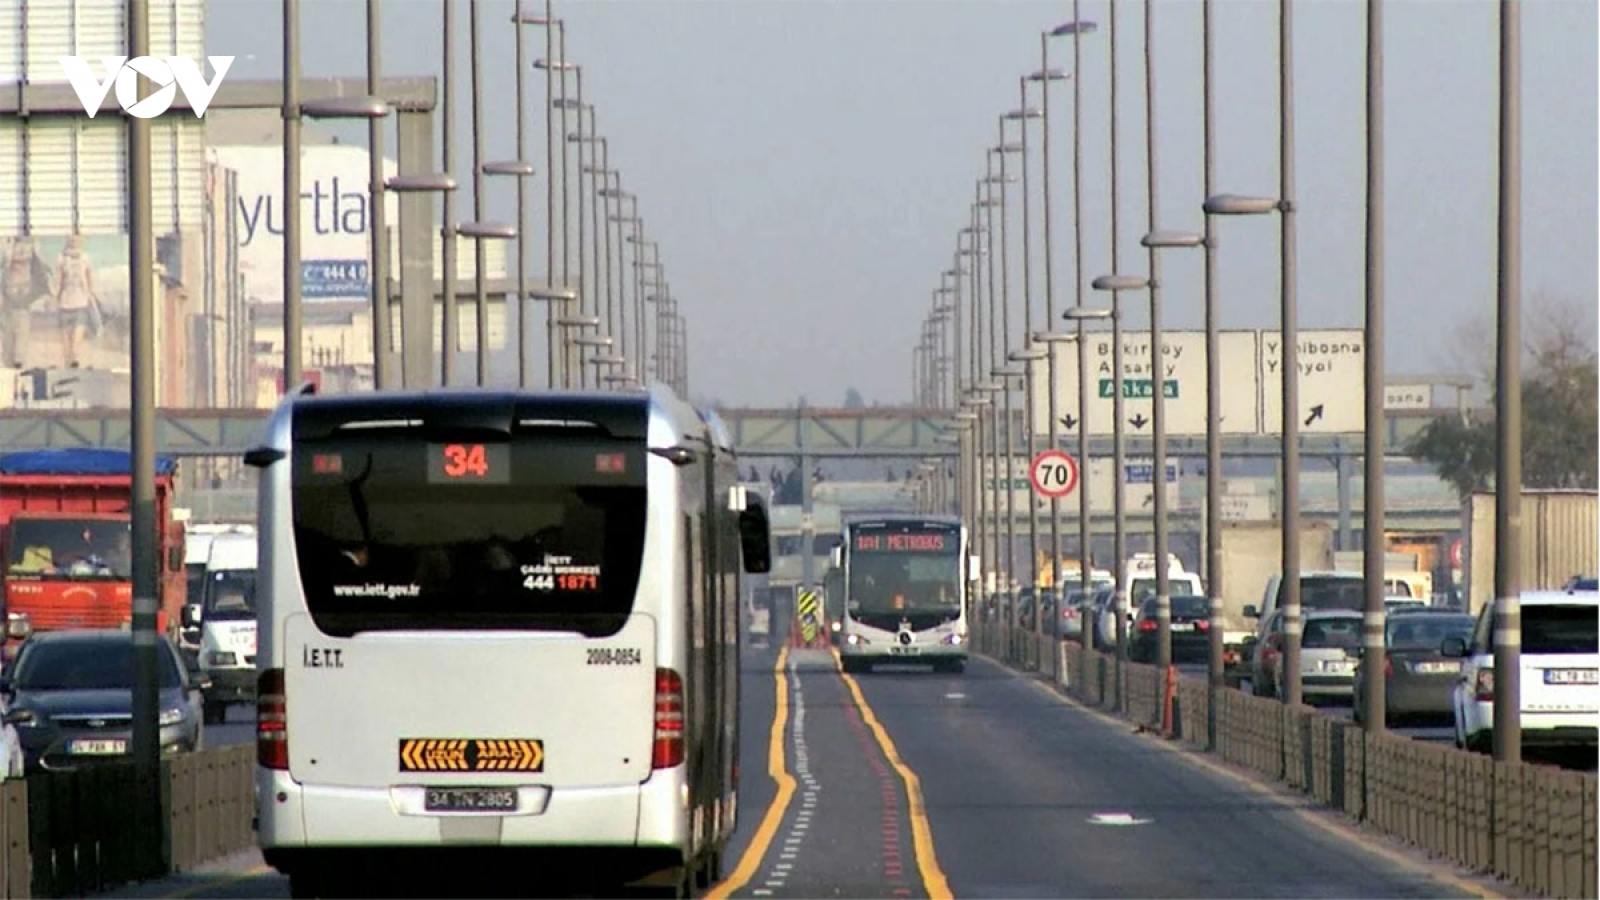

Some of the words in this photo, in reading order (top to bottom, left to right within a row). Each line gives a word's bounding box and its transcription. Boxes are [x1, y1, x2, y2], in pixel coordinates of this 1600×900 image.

[1267, 342, 1361, 355] Yibosna
[1099, 360, 1176, 377] Asary
[1267, 359, 1333, 376] Yyol
[1104, 380, 1175, 396] Ankaa
[444, 444, 489, 477] 34
[1040, 463, 1069, 486] 70
[333, 582, 421, 600] www.iett.gov.tr
[523, 575, 555, 590] 444
[558, 575, 597, 590] 1871
[431, 792, 449, 807] 34
